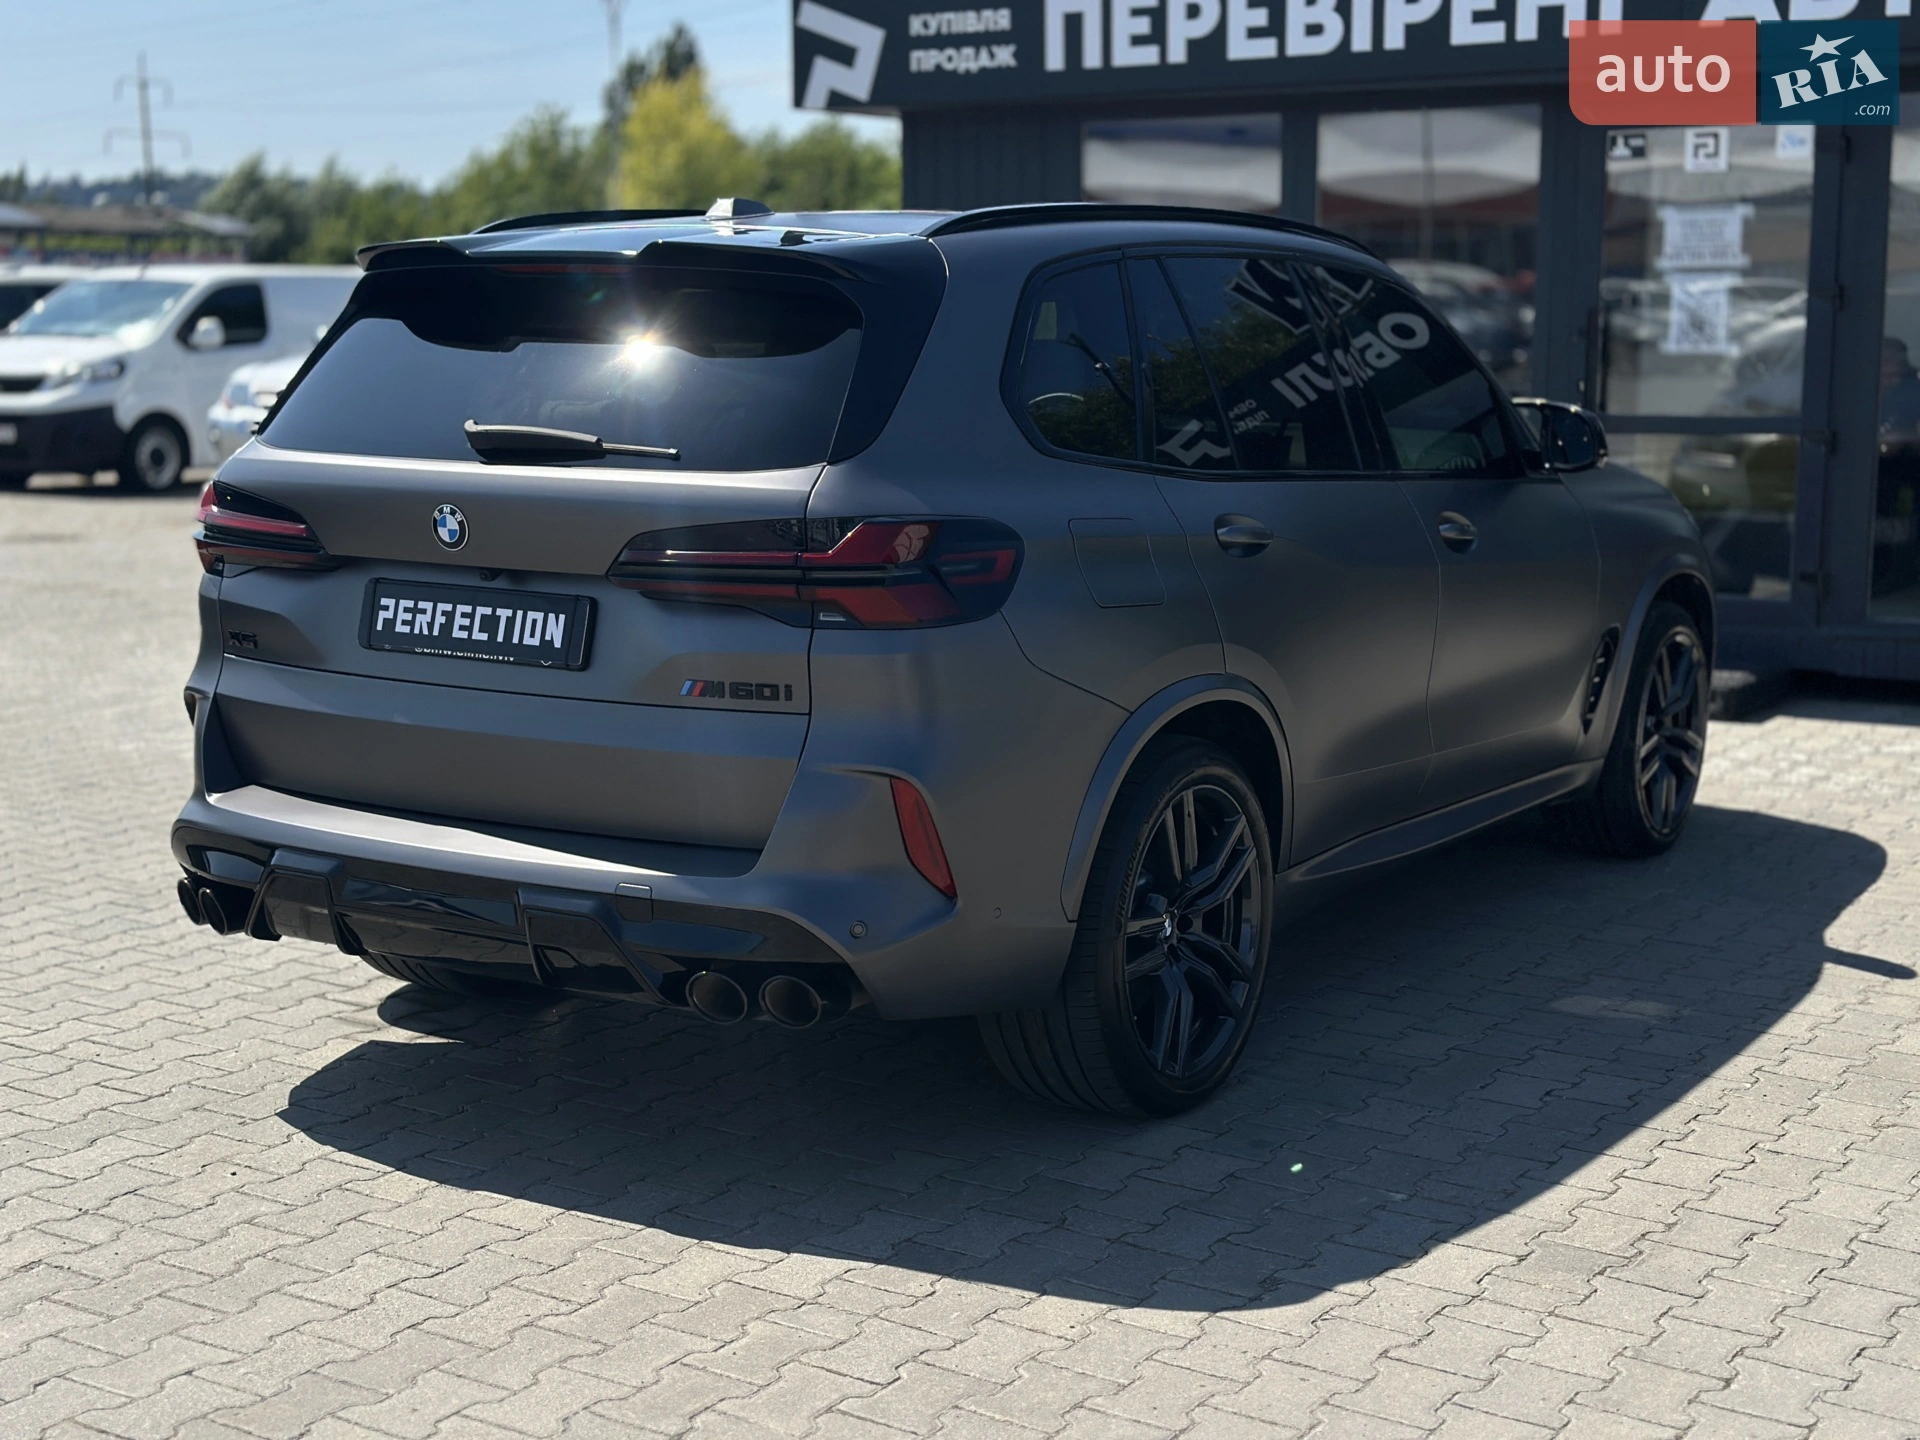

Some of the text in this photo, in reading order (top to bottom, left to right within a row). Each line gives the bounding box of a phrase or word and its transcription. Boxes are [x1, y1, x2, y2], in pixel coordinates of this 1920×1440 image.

[908, 7, 1012, 37] КУПІВЛЯ
[909, 43, 1018, 74] ПРОДАЖ
[434, 506, 463, 522] BMW
[376, 597, 566, 648] PERFECTION
